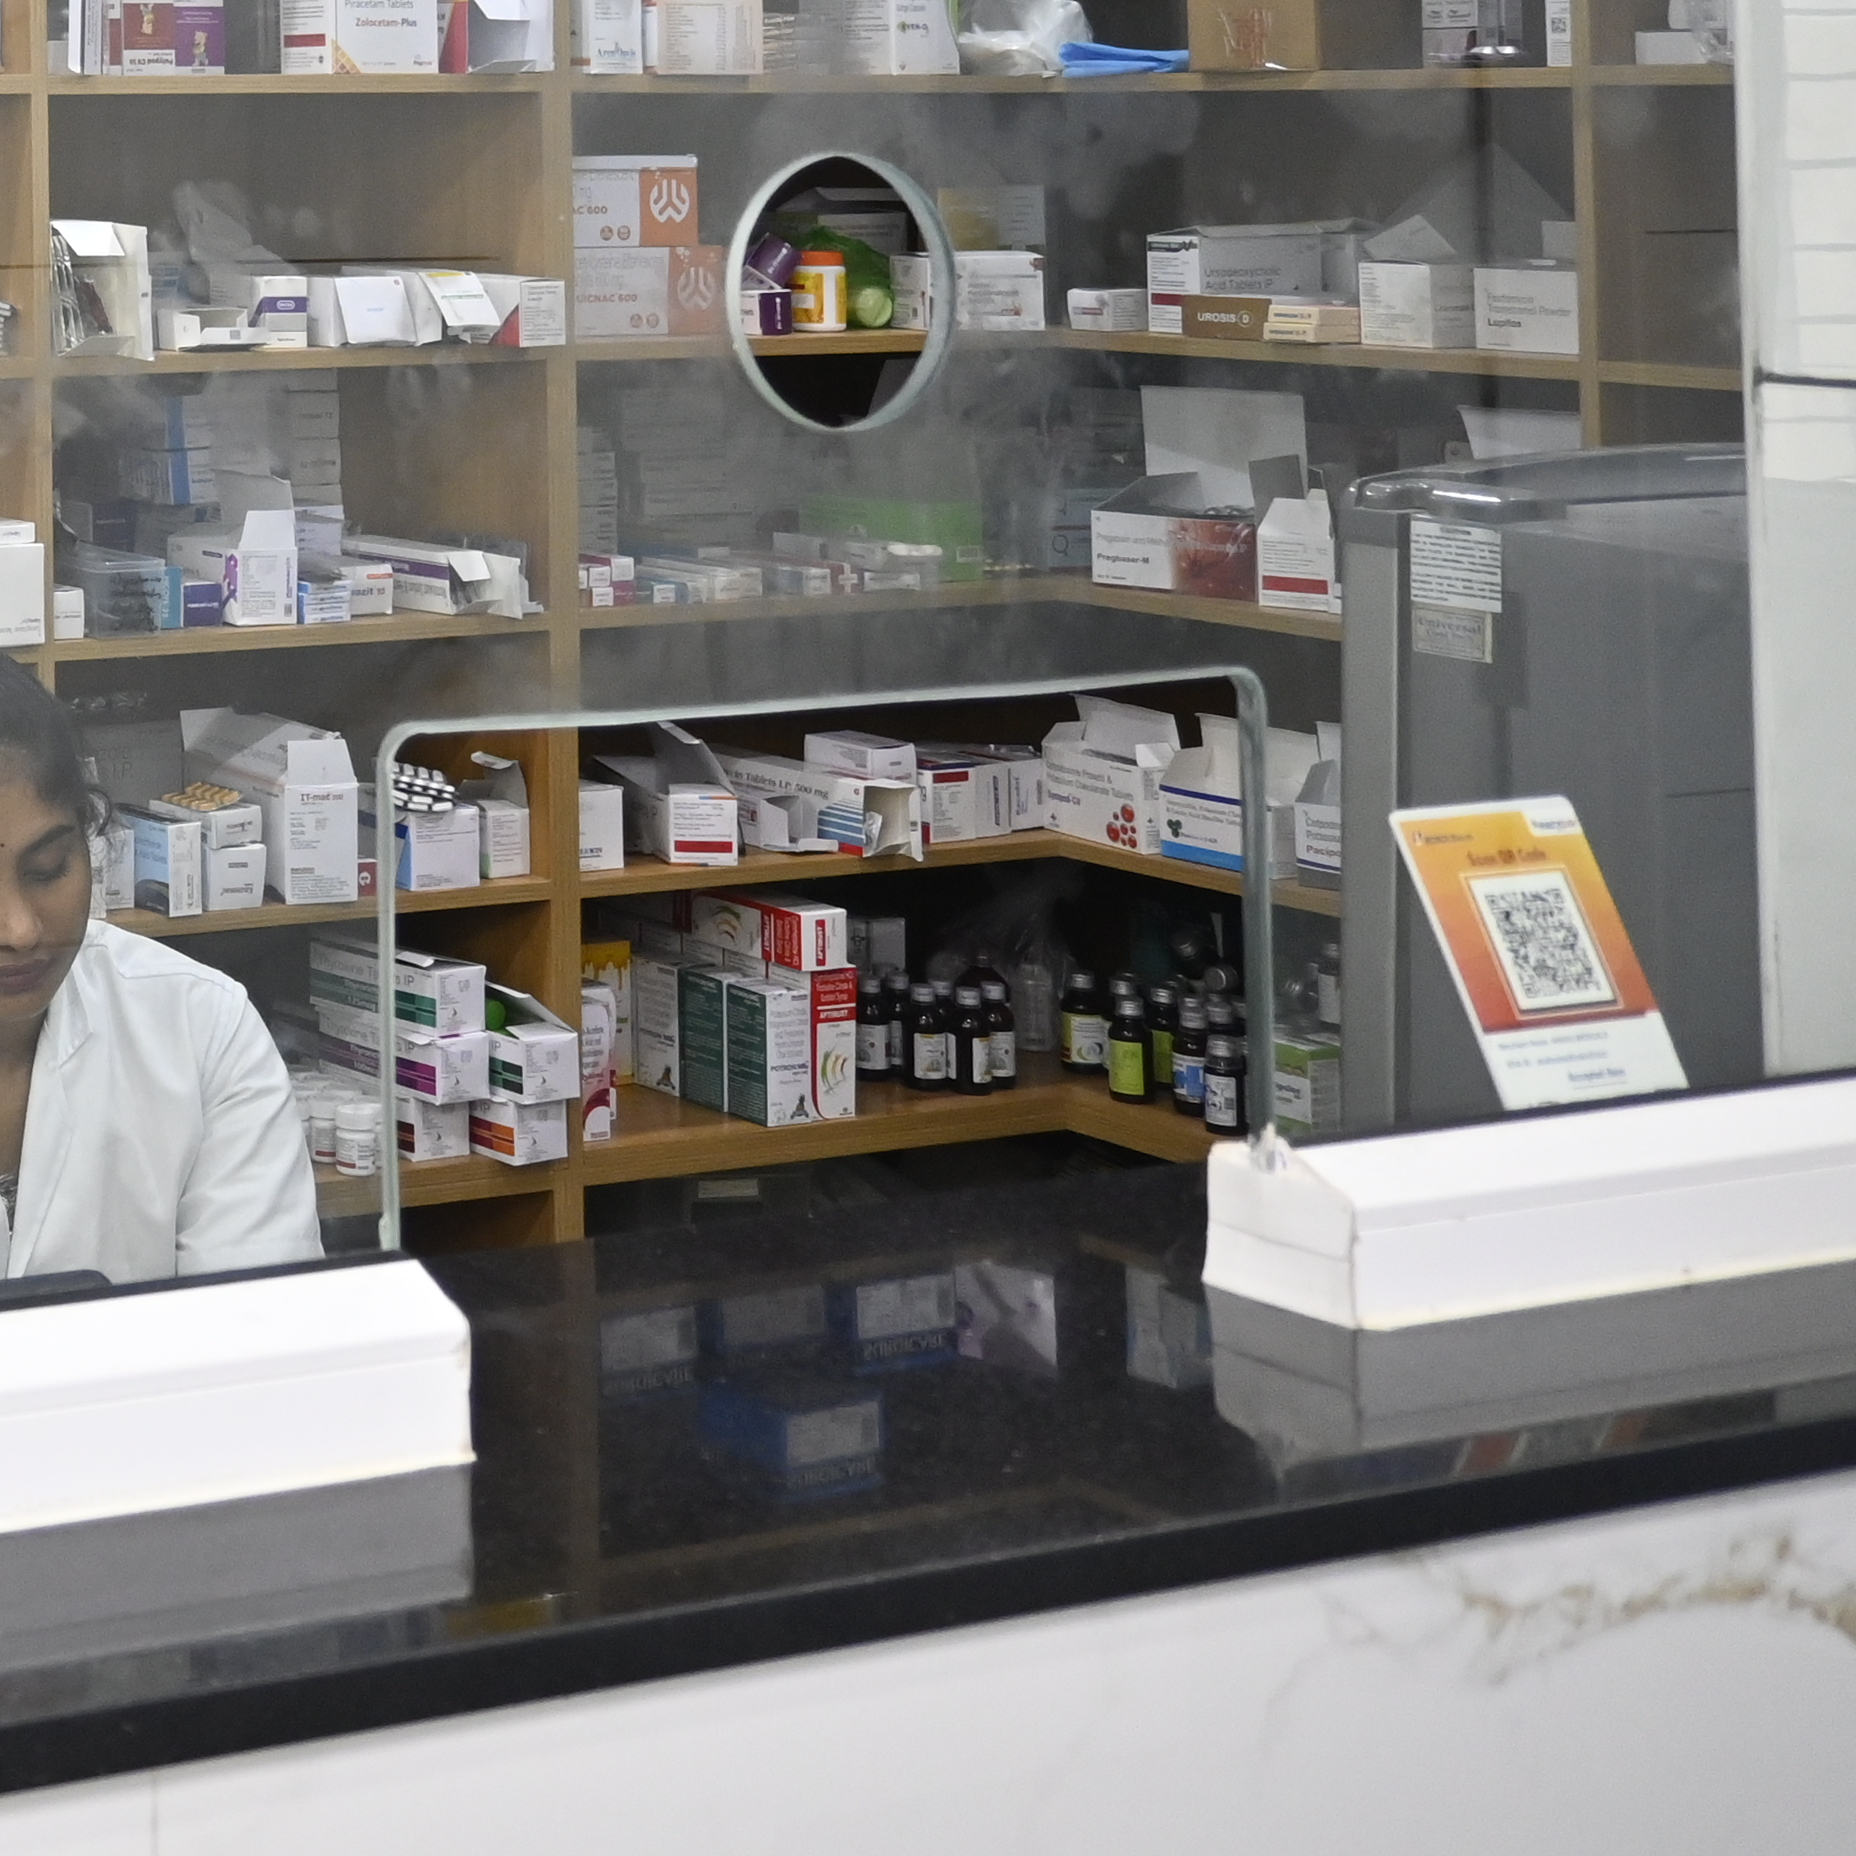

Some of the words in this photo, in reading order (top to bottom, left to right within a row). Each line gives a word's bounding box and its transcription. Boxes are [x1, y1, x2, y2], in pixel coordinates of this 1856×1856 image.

[344, 0, 383, 10] Piracetam
[386, 0, 413, 9] Tablets
[355, 16, 417, 29] Zolocetam-Plus
[587, 205, 608, 215] 600
[1204, 266, 1282, 278] Ursodeoxycholic
[1205, 279, 1225, 290] Acid
[1227, 278, 1261, 290] Tablets
[617, 293, 638, 302] 600
[1540, 305, 1571, 316] Powder
[1197, 311, 1236, 324] UROSIS
[1487, 316, 1522, 328] Lupifos
[1096, 552, 1152, 567] Pregabaser-M
[744, 770, 777, 788] Tablets
[815, 787, 829, 800] mg
[1498, 849, 1515, 865] QR
[1518, 847, 1547, 863] Code
[317, 956, 365, 975] Thyroxine
[404, 974, 414, 985] IP
[404, 1042, 415, 1052] IP
[491, 1040, 501, 1051] IP
[481, 1102, 490, 1111] IP
